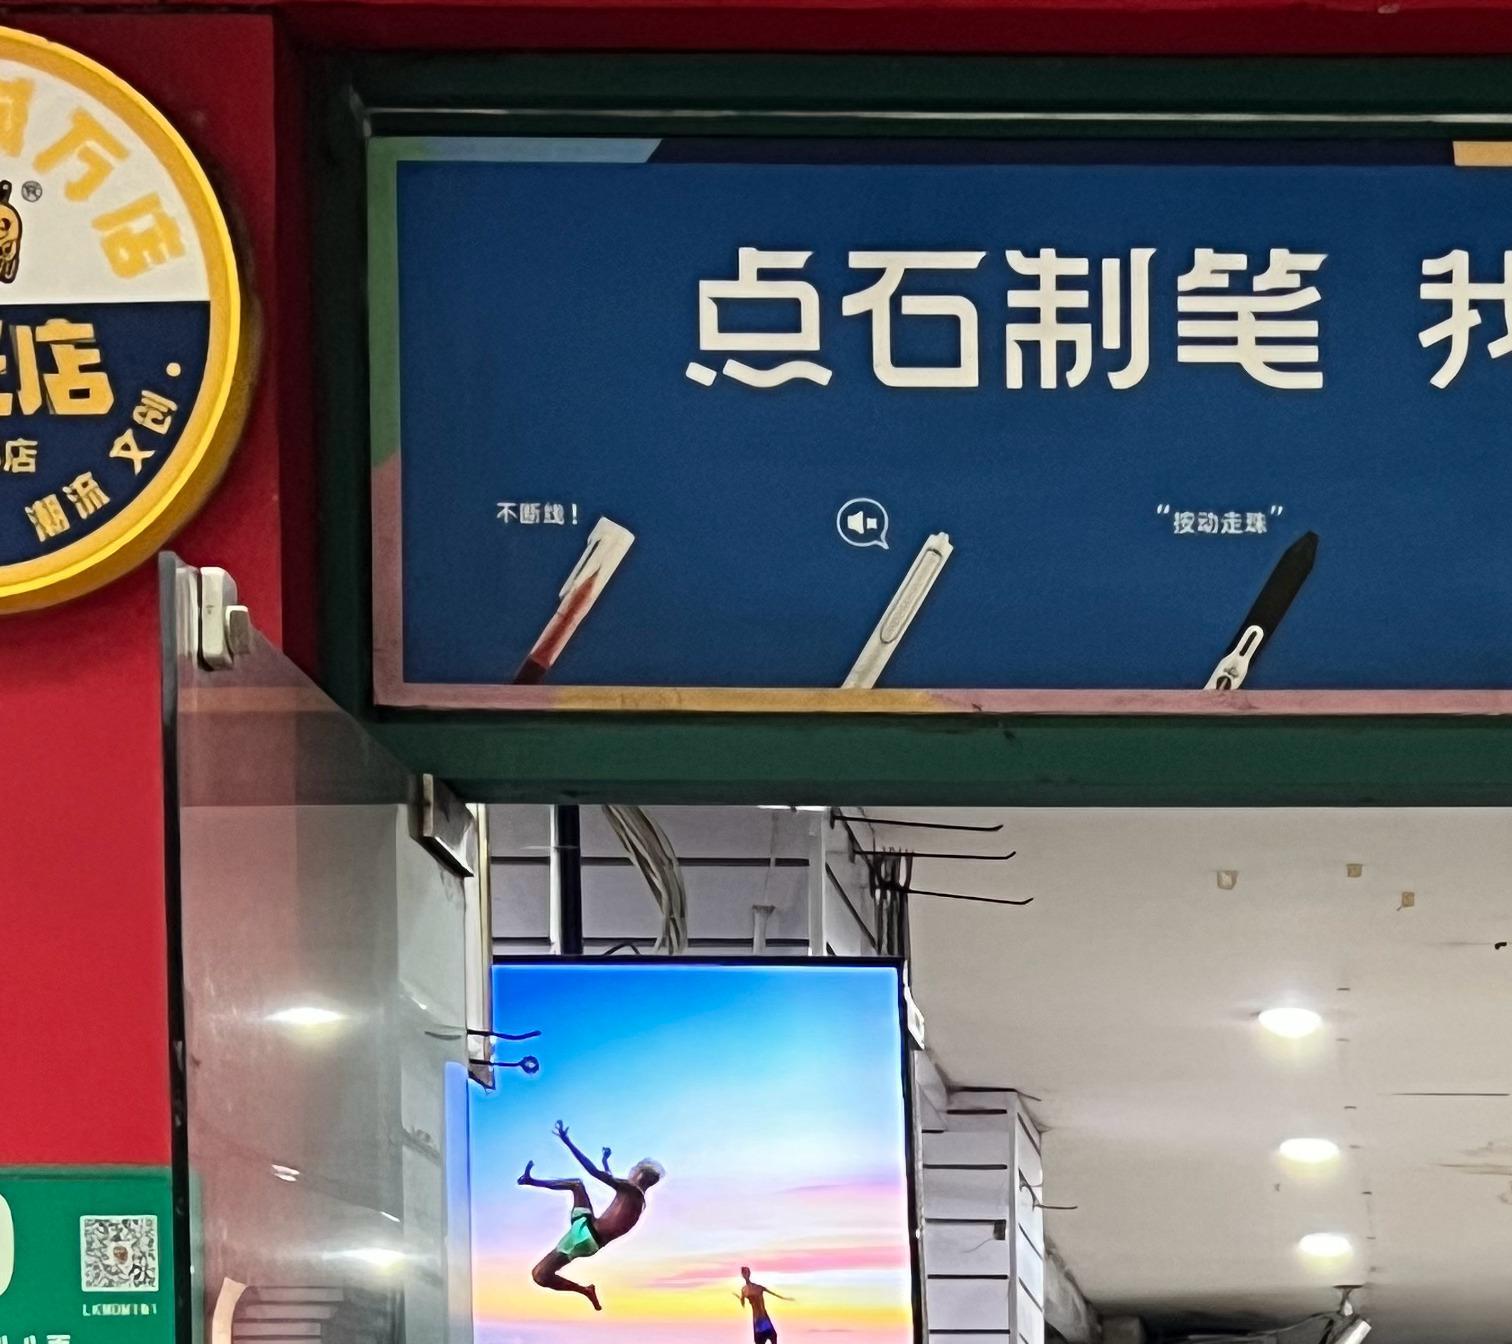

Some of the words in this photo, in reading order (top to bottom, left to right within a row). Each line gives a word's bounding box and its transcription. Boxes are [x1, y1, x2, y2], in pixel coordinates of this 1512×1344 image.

[0, 318, 114, 416] 店
[685, 247, 1328, 389] 点石制笔
[24, 471, 111, 542] 潮流
[109, 389, 179, 476] 文创
